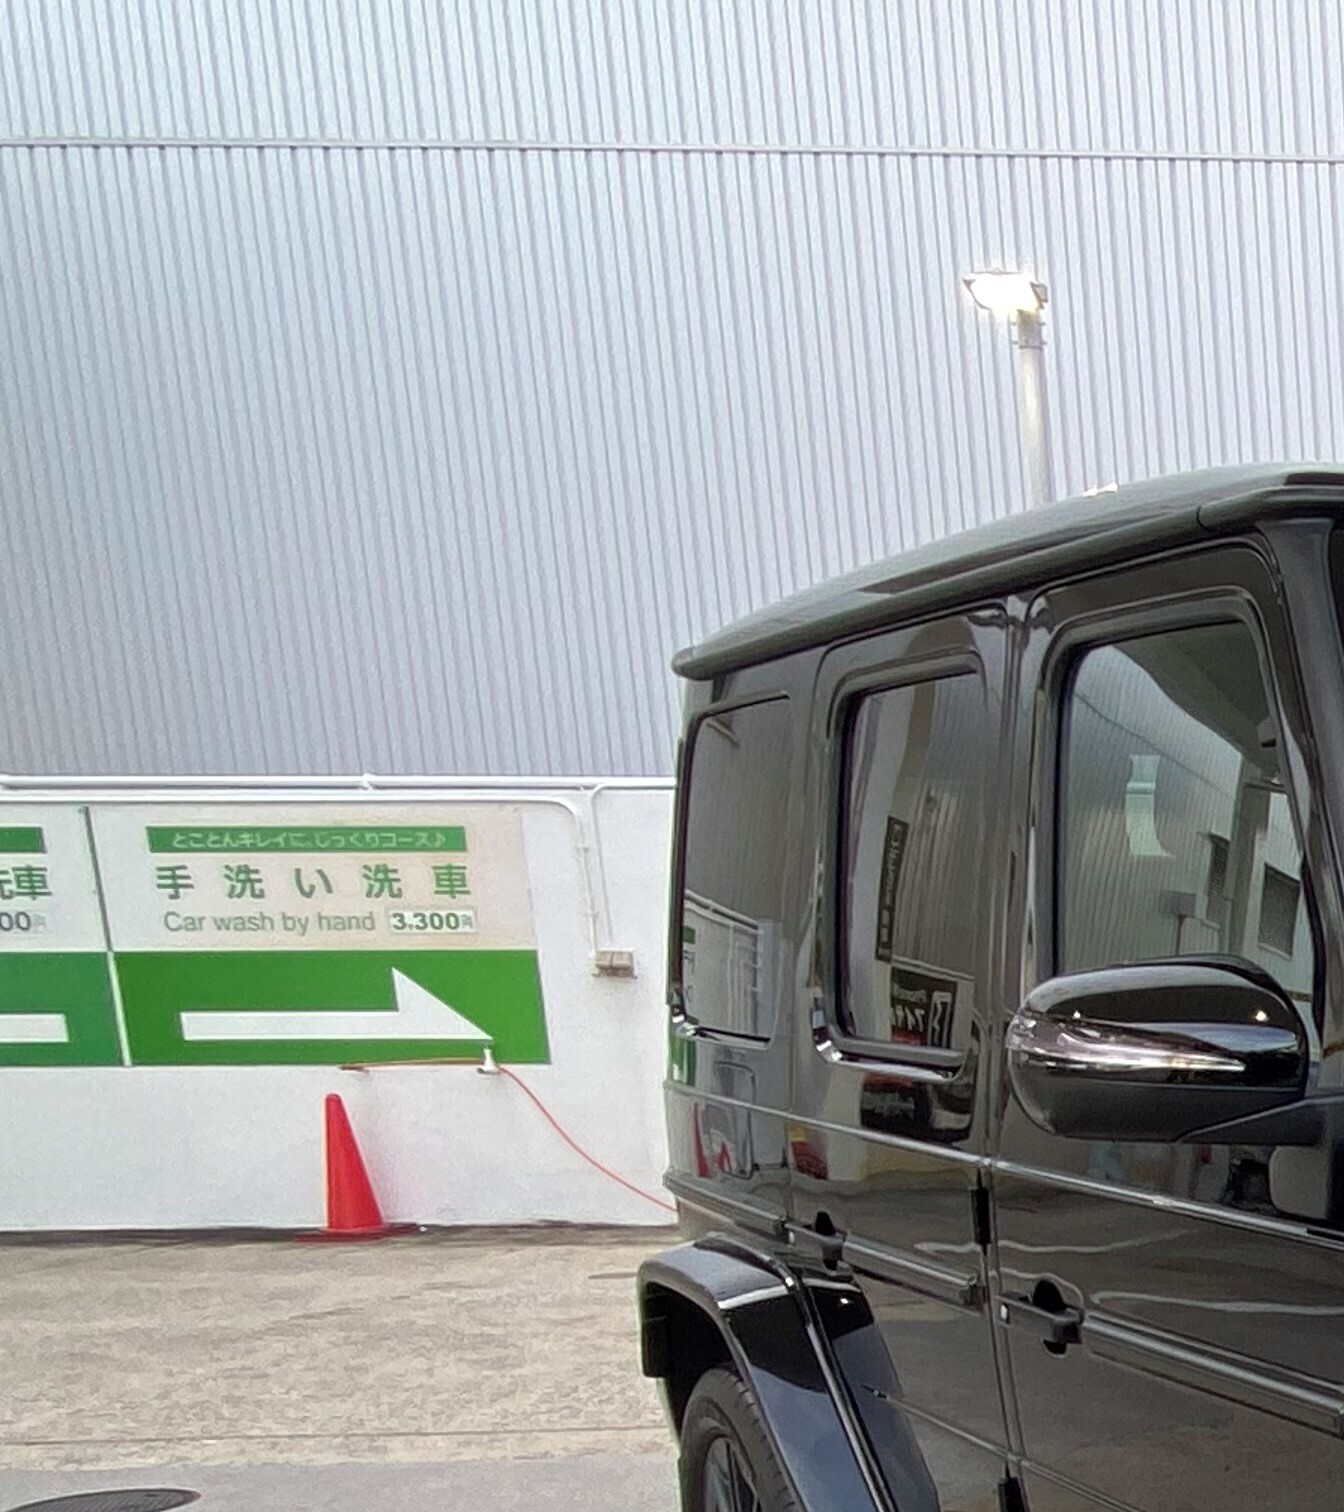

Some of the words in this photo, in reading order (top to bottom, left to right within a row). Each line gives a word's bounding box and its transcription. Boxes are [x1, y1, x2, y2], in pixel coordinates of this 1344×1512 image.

[0, 865, 52, 900] 車
[164, 911, 205, 932] Car
[213, 911, 274, 932] wash
[282, 911, 309, 936] by
[318, 911, 376, 932] hand
